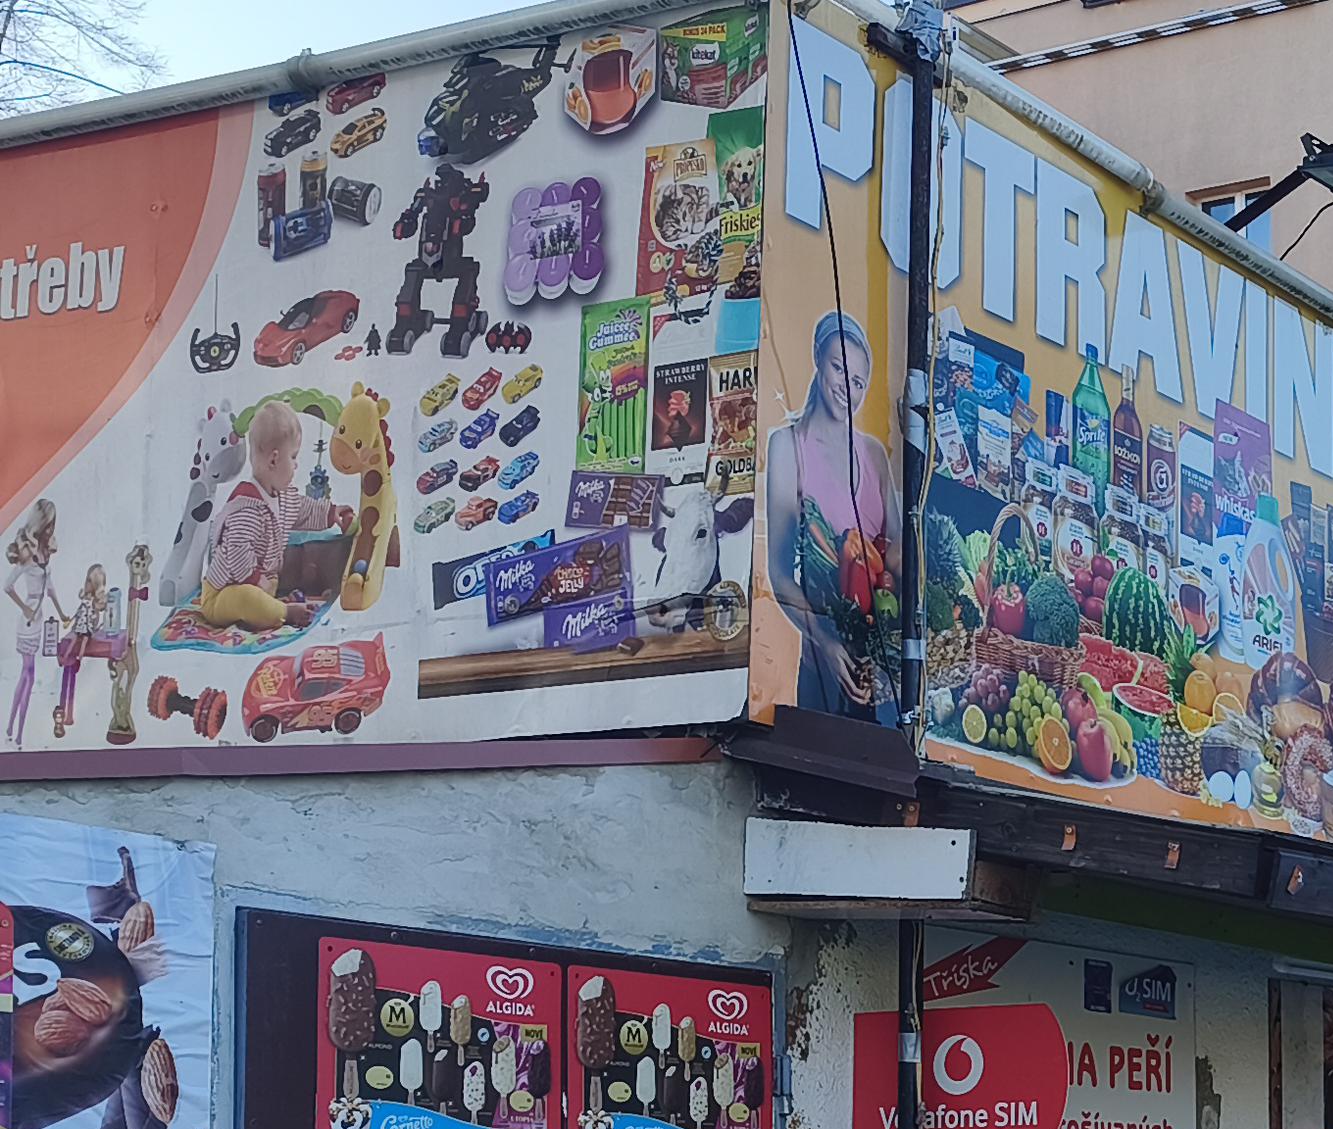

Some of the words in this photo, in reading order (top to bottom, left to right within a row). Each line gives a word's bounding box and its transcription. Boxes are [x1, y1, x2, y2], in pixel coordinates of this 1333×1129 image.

[0, 243, 125, 317] třeby
[656, 363, 705, 379] STRAWBERRY
[1079, 425, 1106, 445] Sprite
[496, 560, 535, 593] Milka
[558, 577, 585, 595] JELLY
[562, 602, 607, 640] Milka
[1142, 978, 1171, 1002] SIM
[486, 1000, 535, 1017] ALGIDA
[708, 1021, 749, 1036] ALGIDA
[1109, 1033, 1173, 1093] PEŘÍ
[994, 1101, 1038, 1128] SIM
